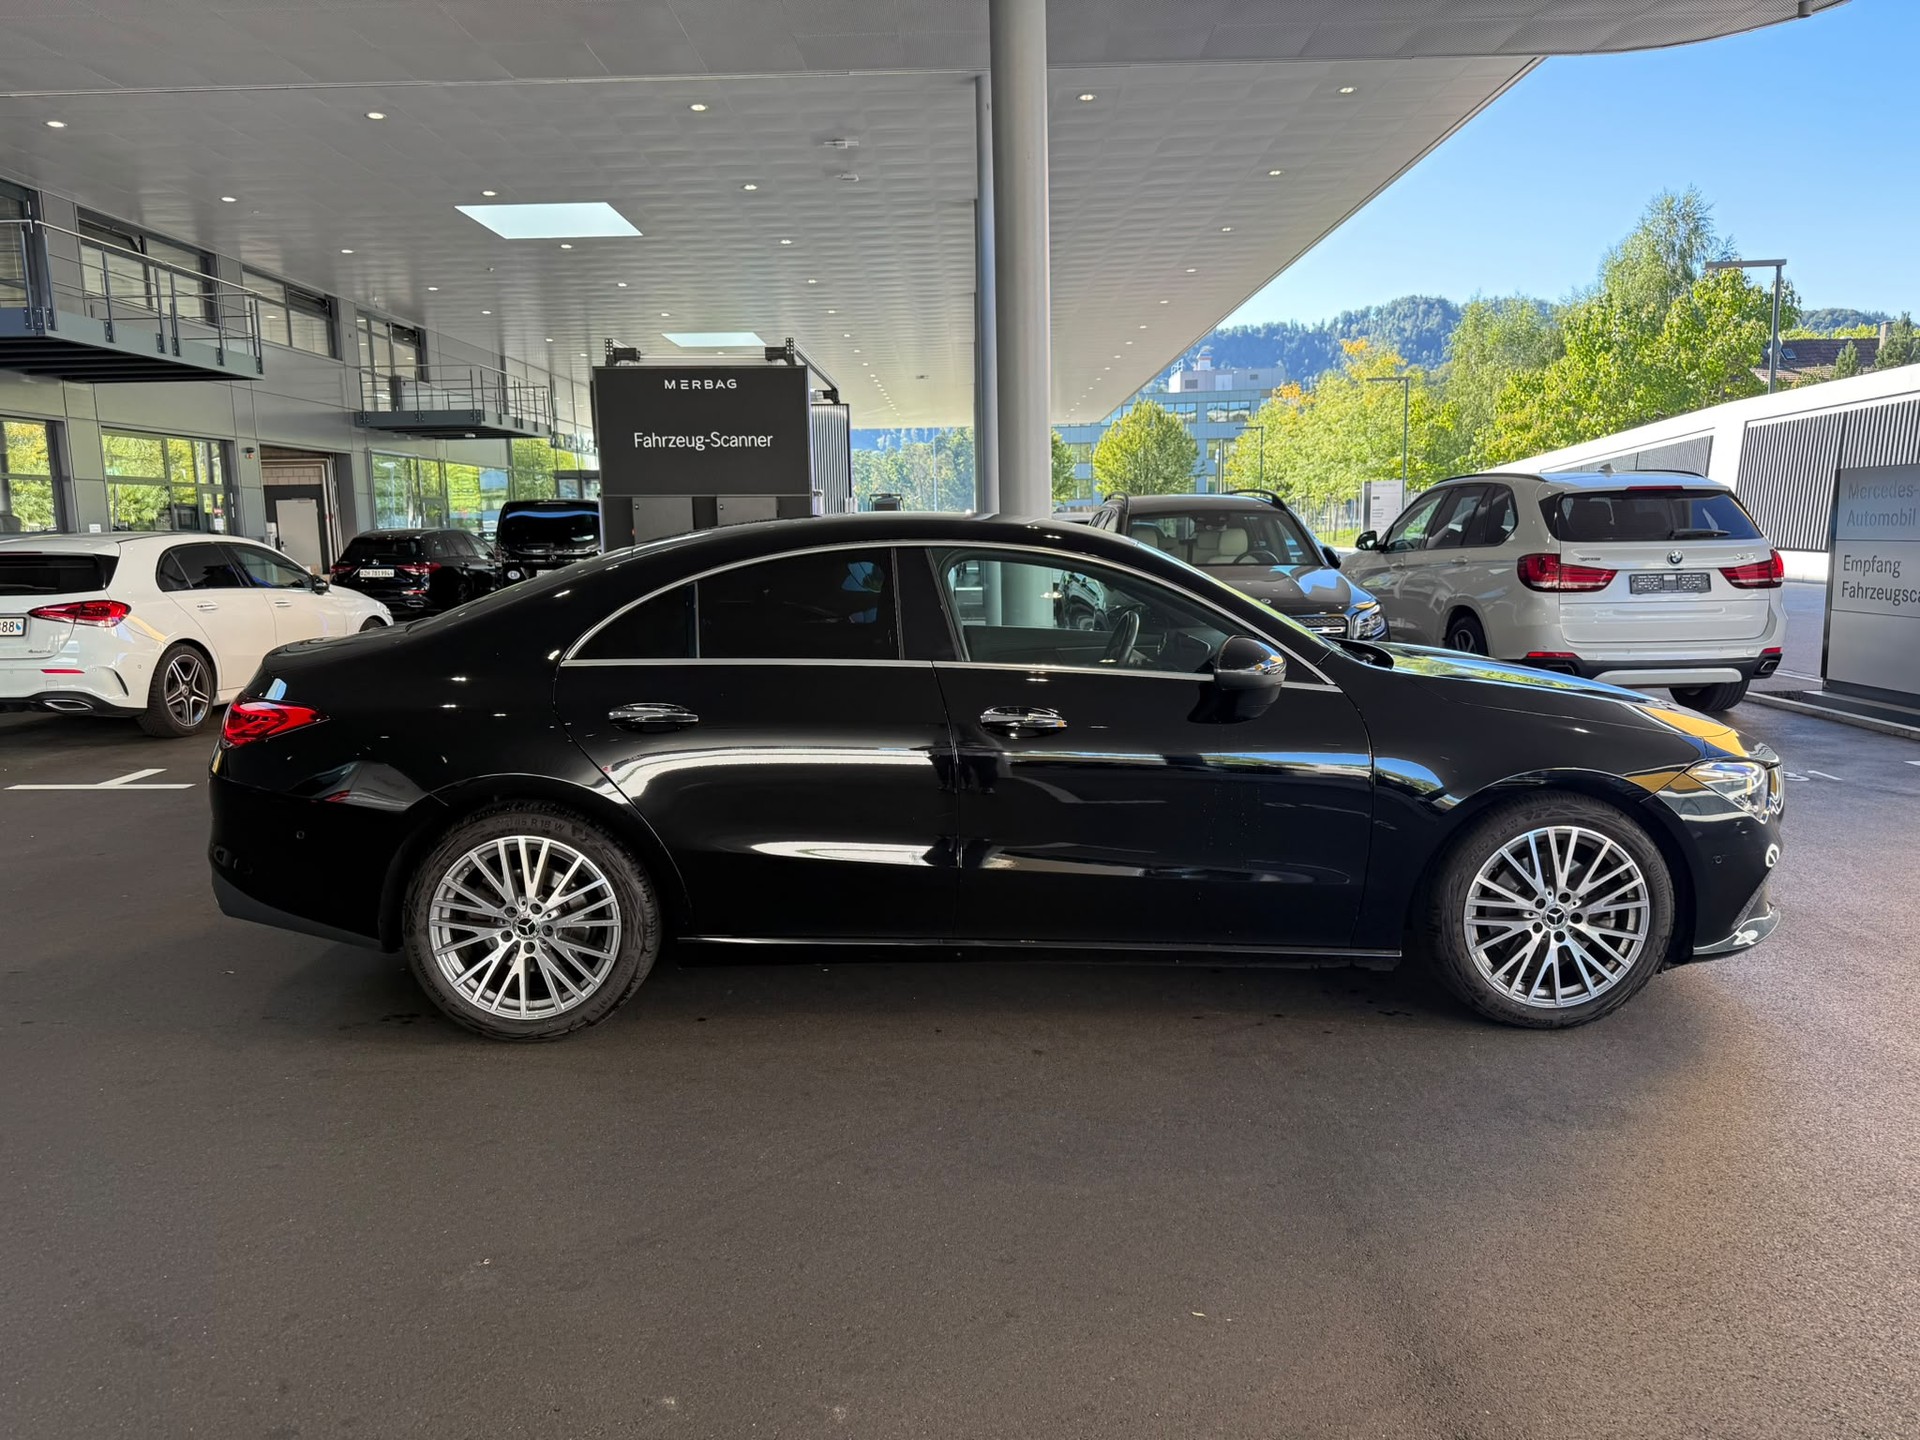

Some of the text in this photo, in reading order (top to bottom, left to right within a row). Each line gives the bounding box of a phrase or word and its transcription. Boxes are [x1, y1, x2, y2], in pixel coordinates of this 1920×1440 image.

[664, 378, 738, 390] MERBAG
[633, 431, 774, 451] Fahrzeug-Scanner
[1846, 508, 1916, 527] Automobil
[1843, 554, 1902, 579] Empfang
[0, 621, 15, 633] 88
